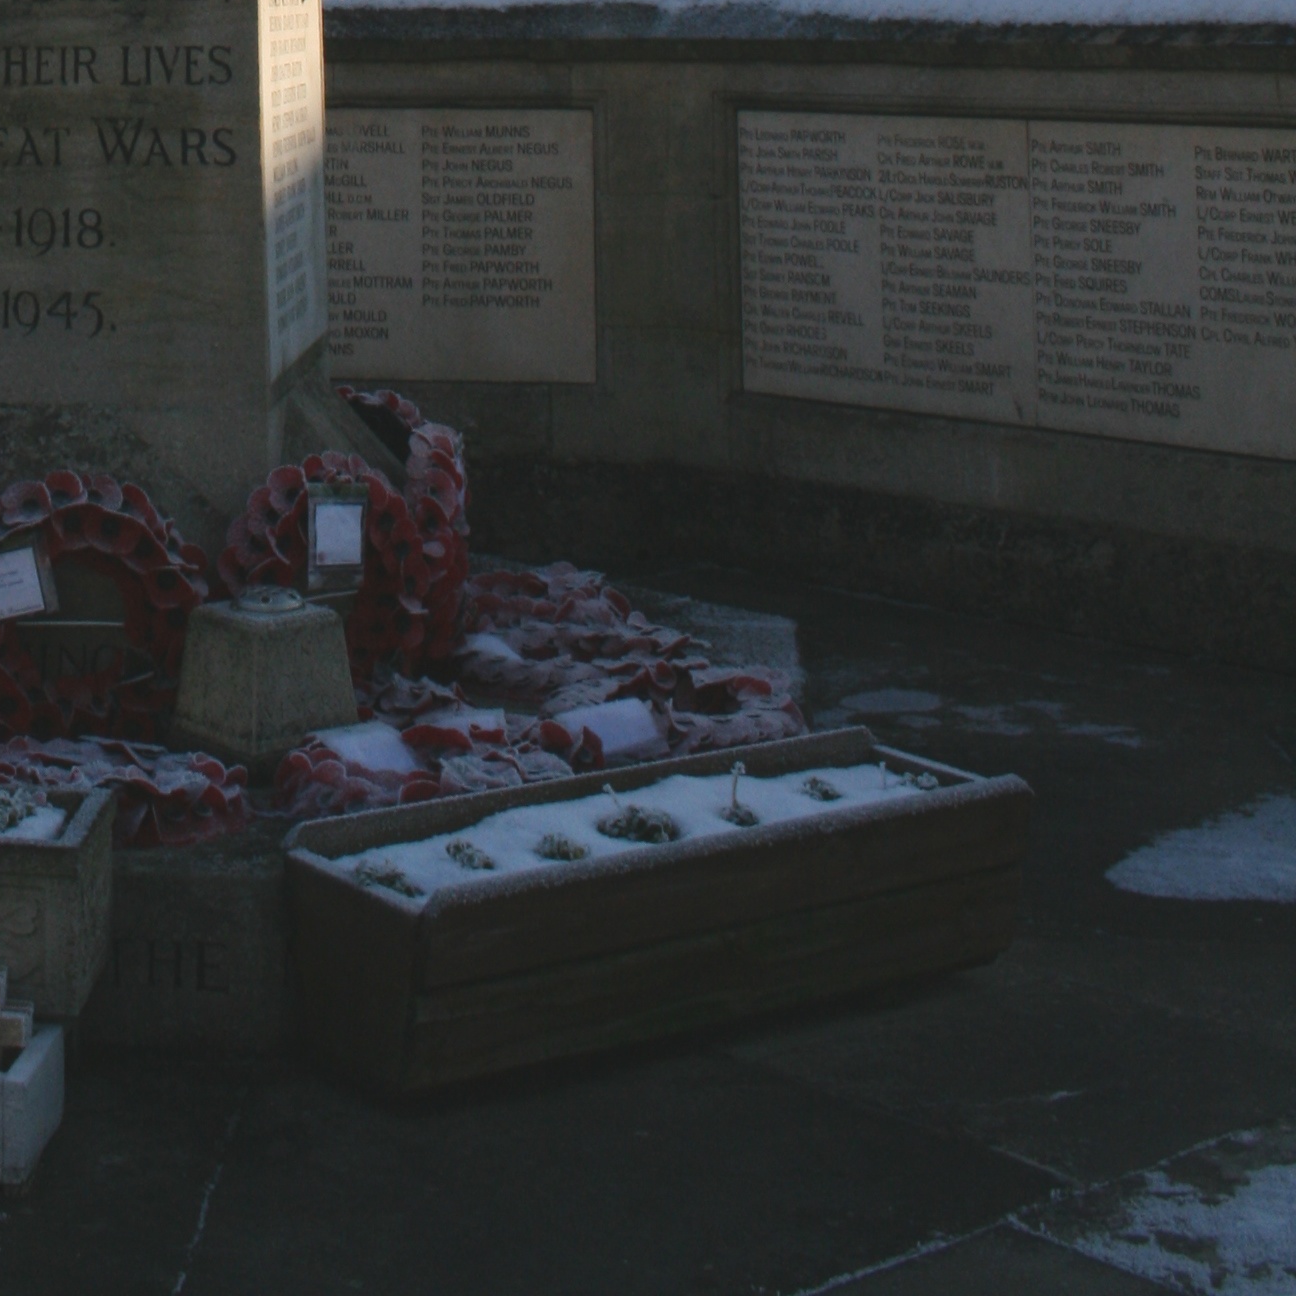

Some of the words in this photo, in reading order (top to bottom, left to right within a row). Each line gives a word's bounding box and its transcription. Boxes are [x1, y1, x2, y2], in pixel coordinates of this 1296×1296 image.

[120, 45, 234, 87] LIVES
[485, 126, 530, 137] MUNNS
[90, 116, 237, 167] WARS
[517, 142, 559, 154] NEGUS
[1085, 142, 1120, 155] SMITH
[471, 159, 512, 171] NEGUS
[1127, 162, 1164, 177] SMITH
[531, 176, 572, 188] NEGUS
[476, 193, 534, 204] OLDFIELD
[366, 210, 408, 220] MILLER
[483, 210, 532, 221] PALMER
[955, 210, 997, 225] SAVAGE
[483, 227, 533, 238] PALMER
[1089, 219, 1141, 235] SNEESBY
[484, 244, 526, 255] PAMBY
[1083, 238, 1111, 252] SOLE
[470, 261, 539, 272] PAPWORTH
[353, 277, 412, 288] MOTTRAM
[483, 278, 552, 290] PAPWORTH
[1078, 277, 1127, 293] SQUIRES
[933, 283, 976, 299] SEAMAN
[469, 295, 539, 307] PAPWORTH
[1140, 301, 1190, 318] STALLAN
[343, 311, 386, 321] MOULD
[343, 327, 388, 339] MOXON
[1119, 319, 1196, 339] STEPHENSON
[1128, 359, 1172, 376] TAYLOR
[958, 379, 993, 395] SMART
